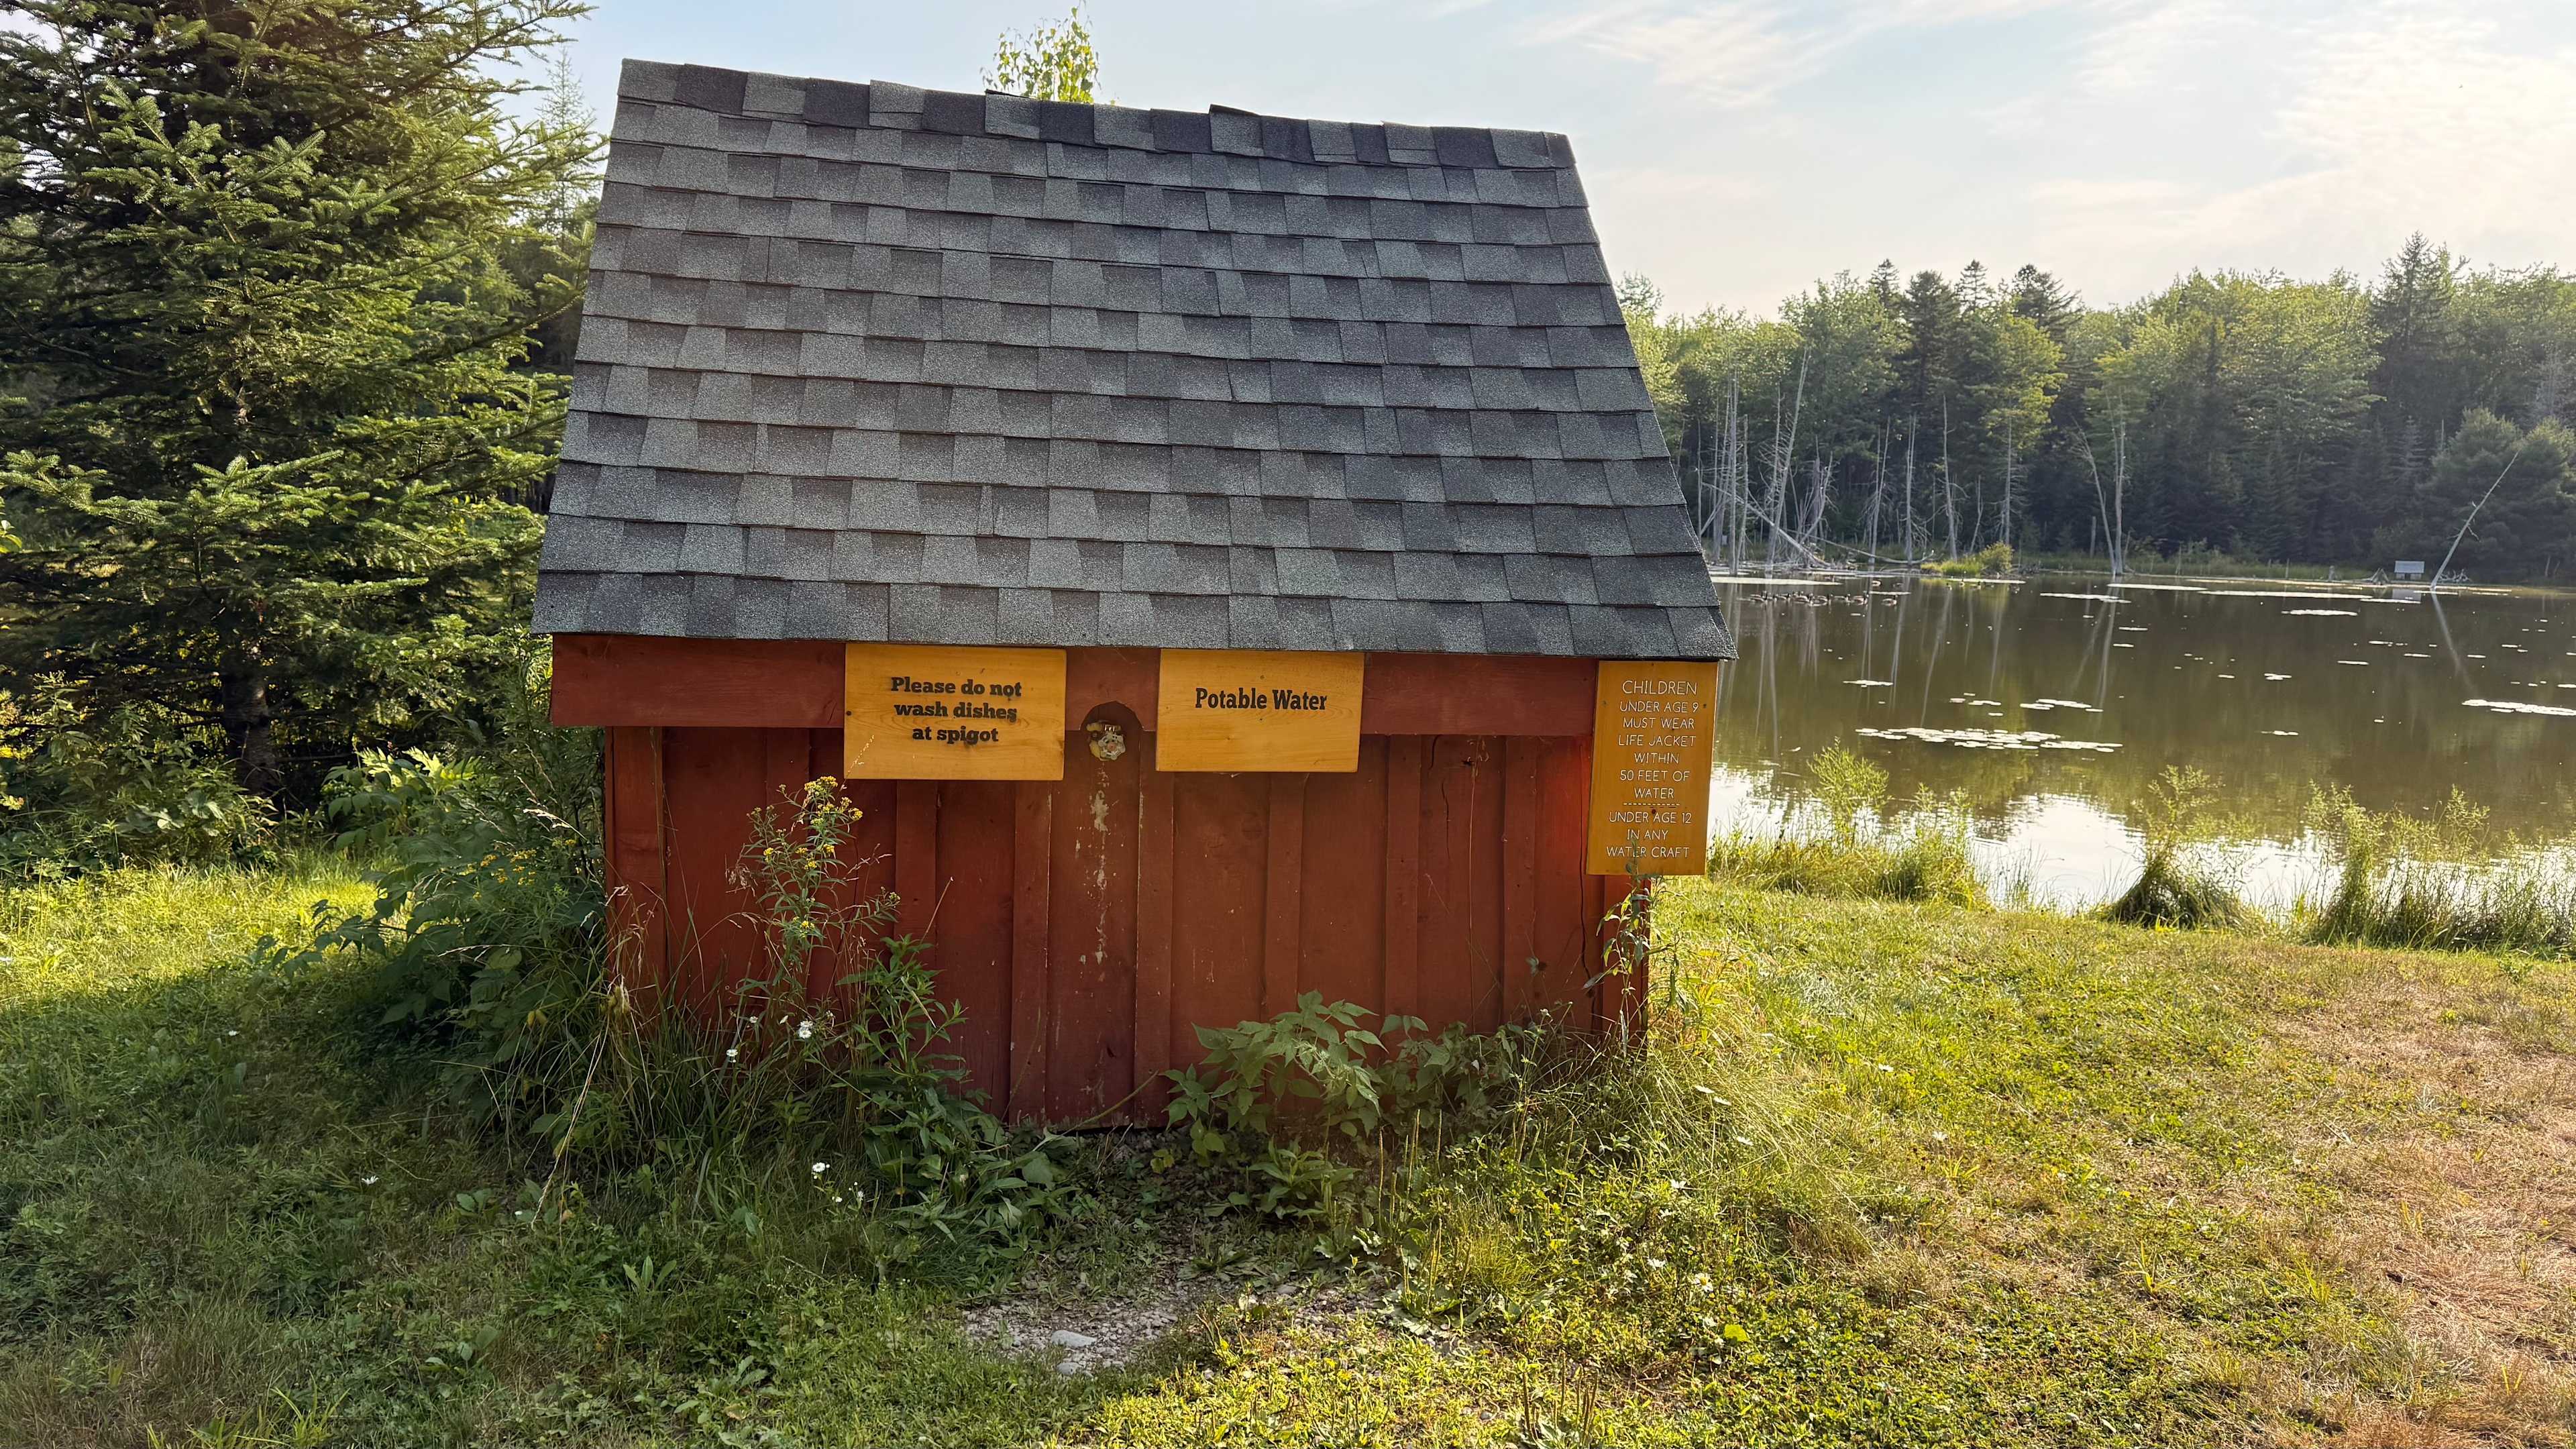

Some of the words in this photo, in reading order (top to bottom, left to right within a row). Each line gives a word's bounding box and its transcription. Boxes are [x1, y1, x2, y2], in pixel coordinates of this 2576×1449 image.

[891, 676, 956, 694] Please
[961, 679, 985, 695] do
[989, 682, 1022, 698] not
[1622, 680, 1697, 695] CHILDREN
[1195, 687, 1267, 709] Potable
[1272, 689, 1327, 710] Water
[894, 701, 948, 716] wash
[953, 702, 1017, 722] dishes
[1620, 701, 1660, 712] UNDER
[1664, 702, 1688, 713] AGE
[1693, 702, 1699, 713] 9
[1623, 717, 1656, 729] MUST
[1661, 718, 1695, 729] WEAR
[912, 727, 932, 741] at
[936, 726, 999, 745] spigot
[1618, 735, 1644, 746] LIFE
[1649, 735, 1696, 747] JACKET
[1634, 753, 1680, 763] WITHIN
[1620, 769, 1634, 781] 50
[1638, 769, 1668, 782] FEET
[1672, 770, 1690, 782] OF
[1634, 788, 1674, 799] WATER
[1609, 812, 1648, 823] UNDER
[1653, 812, 1676, 823] AGE
[1682, 812, 1691, 824] 12
[1627, 828, 1640, 840] IN
[1644, 829, 1669, 840] ANY
[1606, 847, 1646, 857] WATER
[1651, 847, 1690, 858] CRAFT
